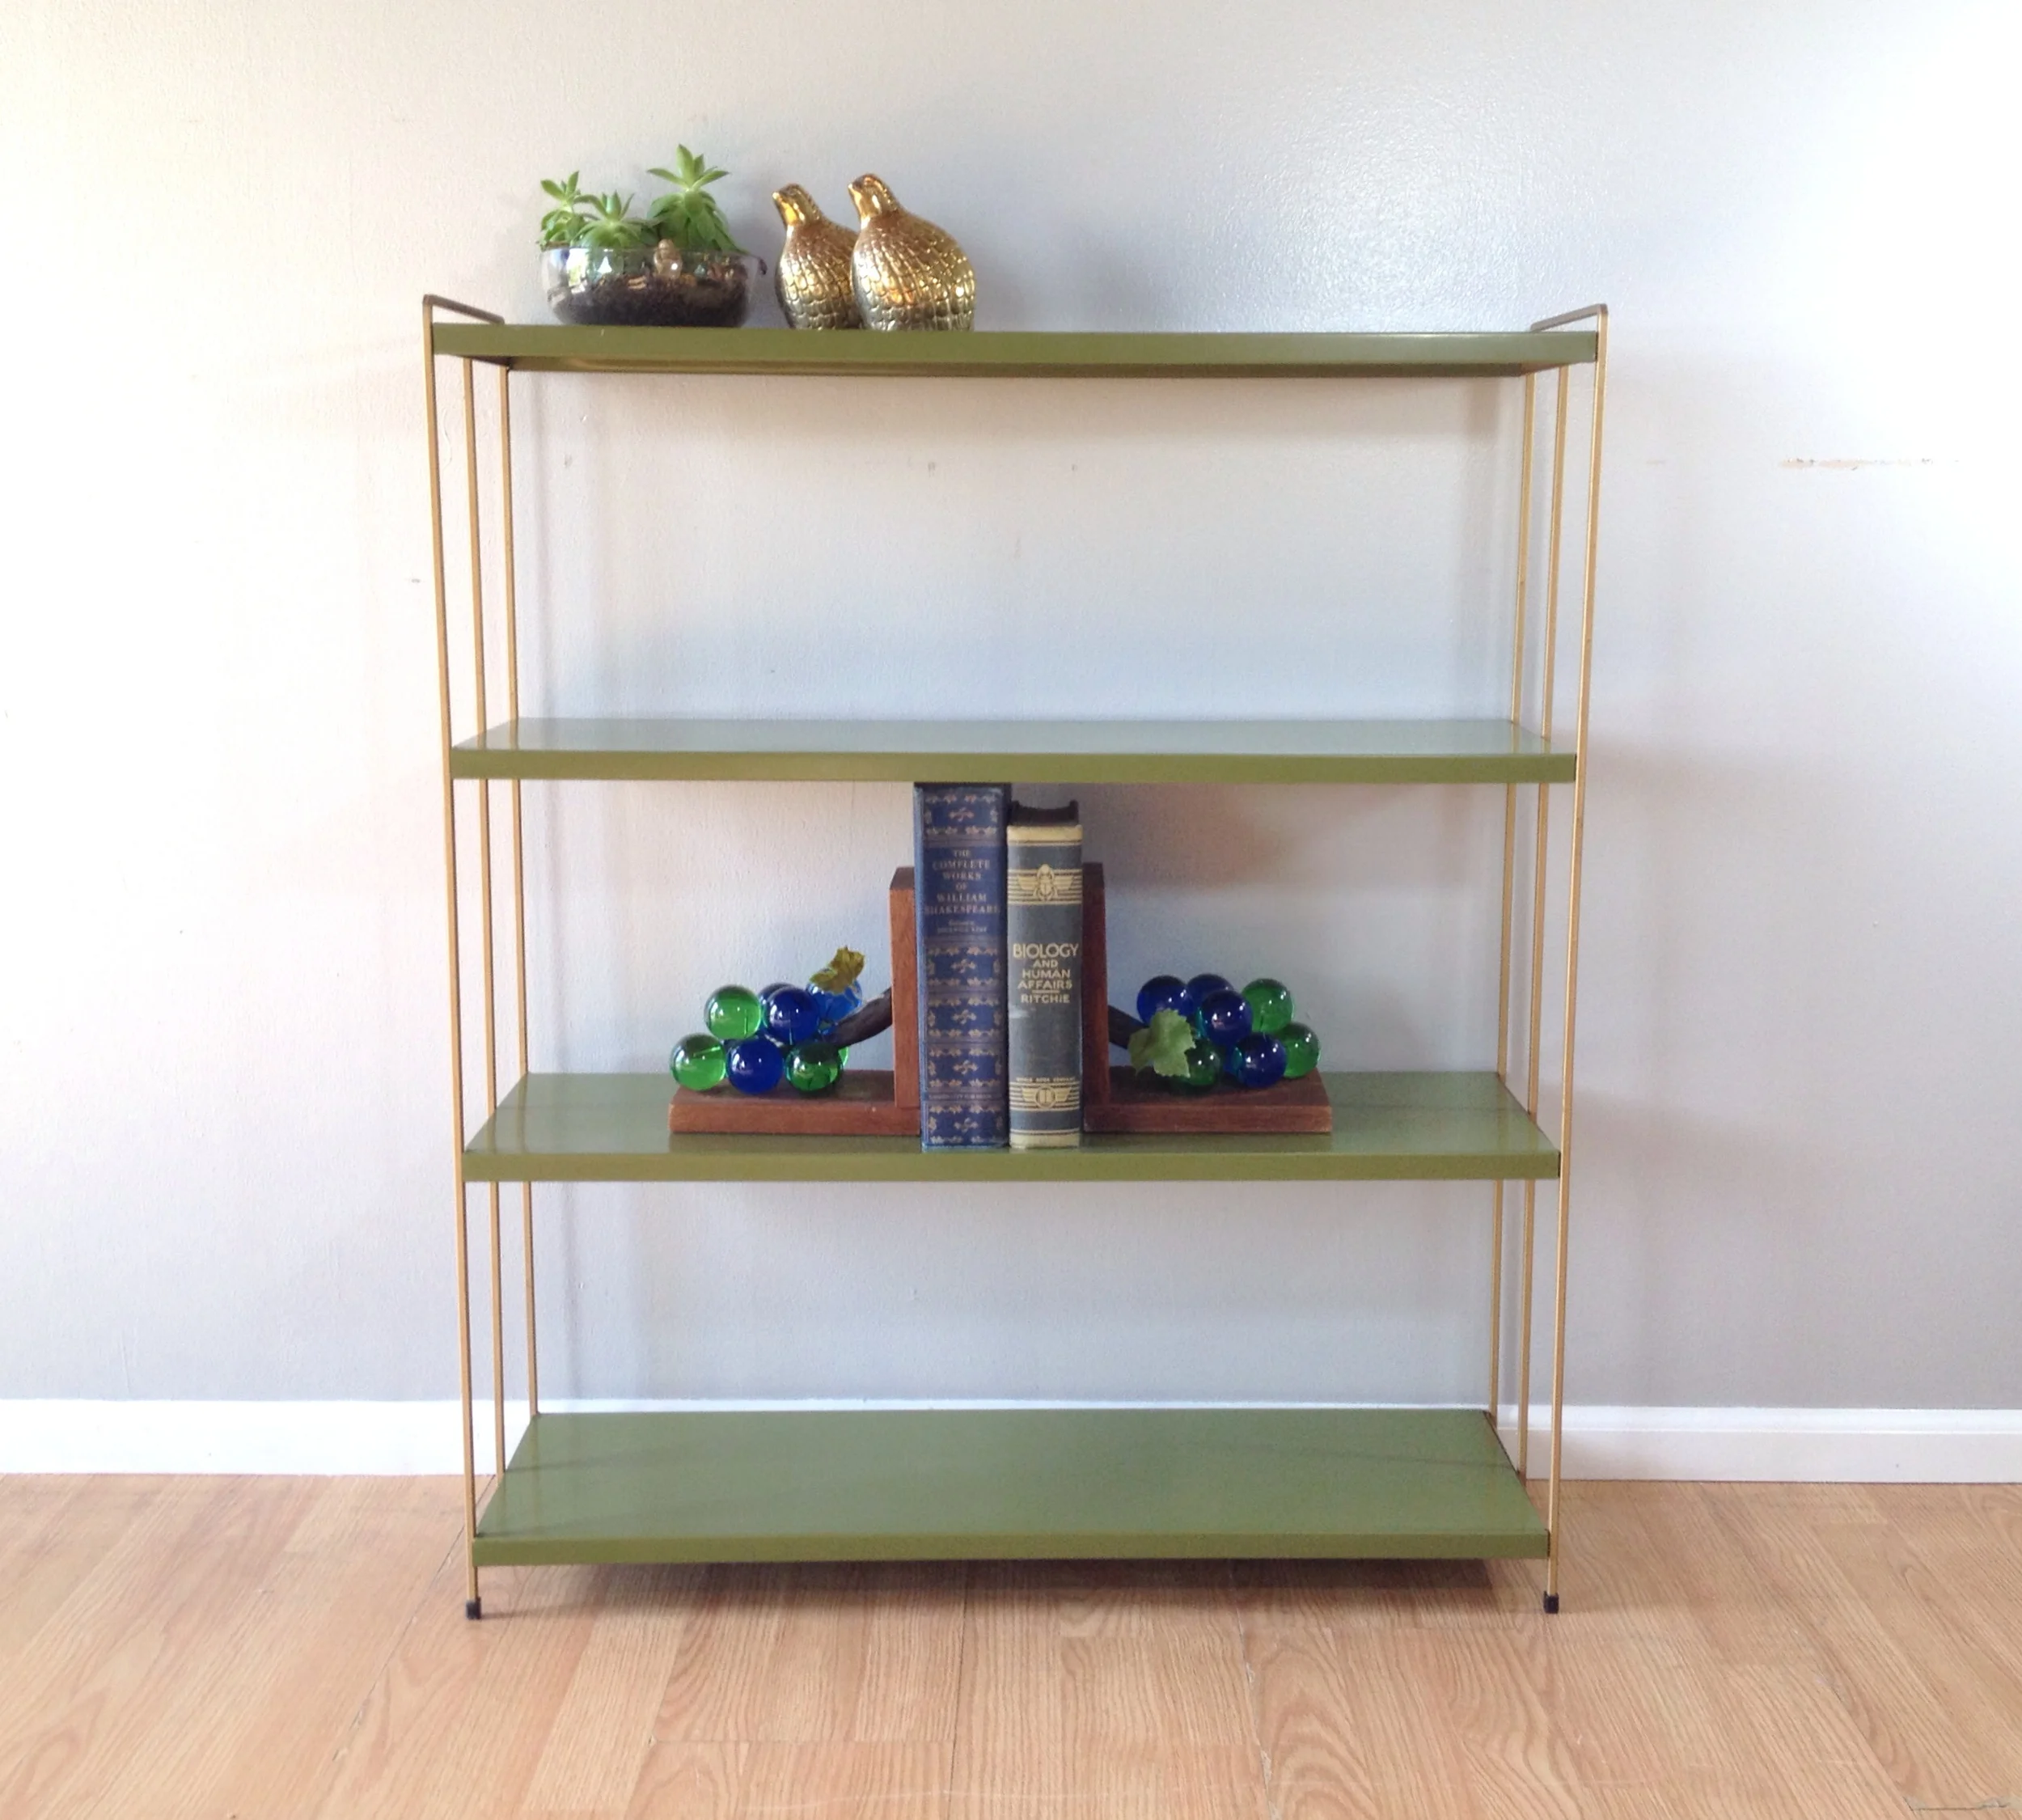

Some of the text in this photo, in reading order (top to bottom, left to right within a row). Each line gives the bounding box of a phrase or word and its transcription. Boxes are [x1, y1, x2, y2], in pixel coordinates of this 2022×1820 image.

[942, 871, 982, 881] WORKS
[937, 893, 987, 903] WILLIAM
[1013, 942, 1079, 959] BIOLOGY
[1032, 959, 1059, 968] AND
[1022, 969, 1071, 979] HUMAN
[1017, 980, 1072, 989] AFFAIRS
[1021, 994, 1070, 1003] RITCHIE
